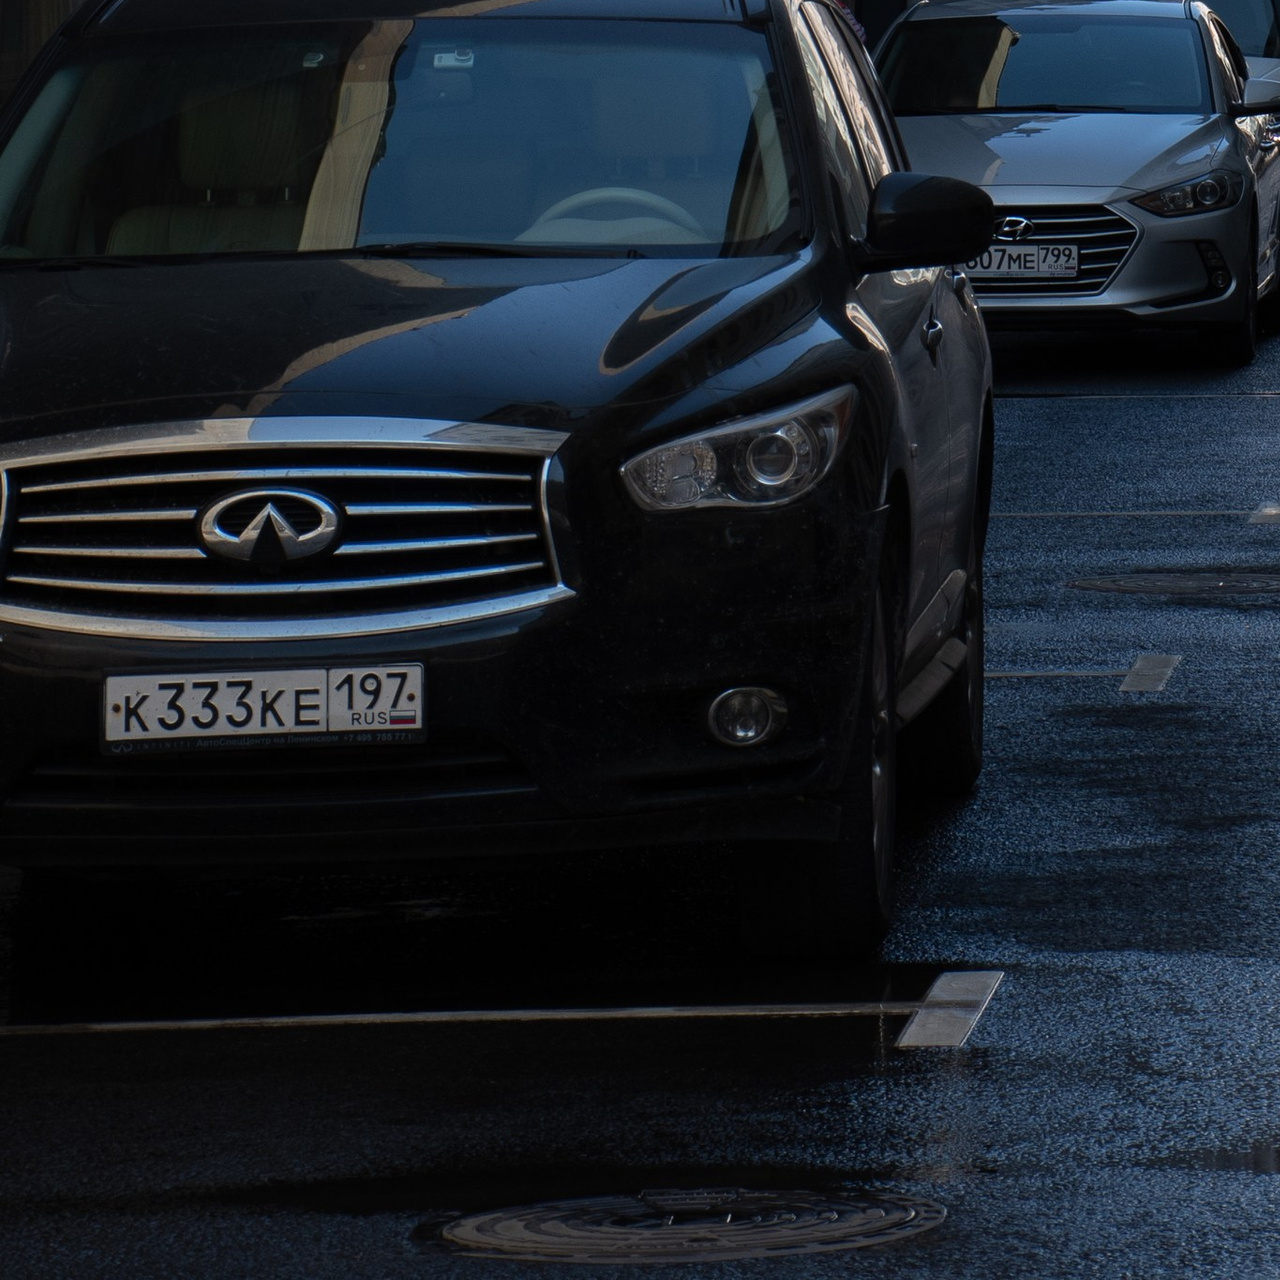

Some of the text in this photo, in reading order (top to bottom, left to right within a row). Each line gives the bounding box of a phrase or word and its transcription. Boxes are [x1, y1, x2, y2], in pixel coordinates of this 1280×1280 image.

[1040, 247, 1072, 263] 799
[335, 671, 409, 711] 197
[351, 712, 388, 726] RUS
[287, 734, 339, 744] Ленинском
